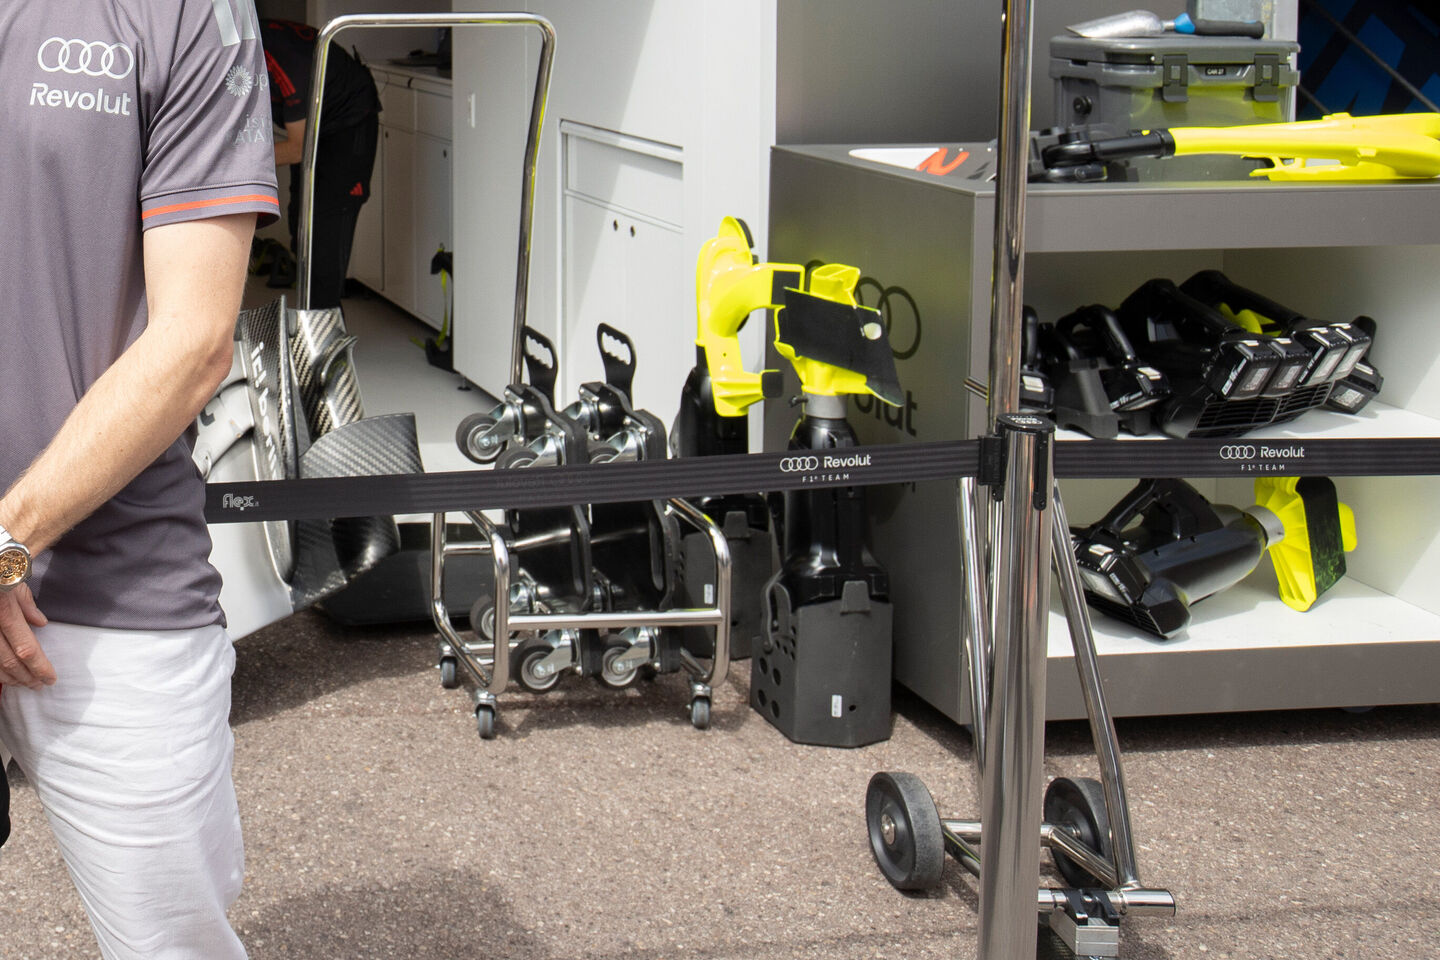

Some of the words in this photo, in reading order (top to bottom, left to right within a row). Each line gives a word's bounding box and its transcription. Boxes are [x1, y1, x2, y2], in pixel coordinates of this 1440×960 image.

[29, 82, 132, 116] Revolut
[1260, 446, 1305, 458] Revolut
[824, 453, 871, 469] Revolut
[821, 473, 850, 482] TEAM
